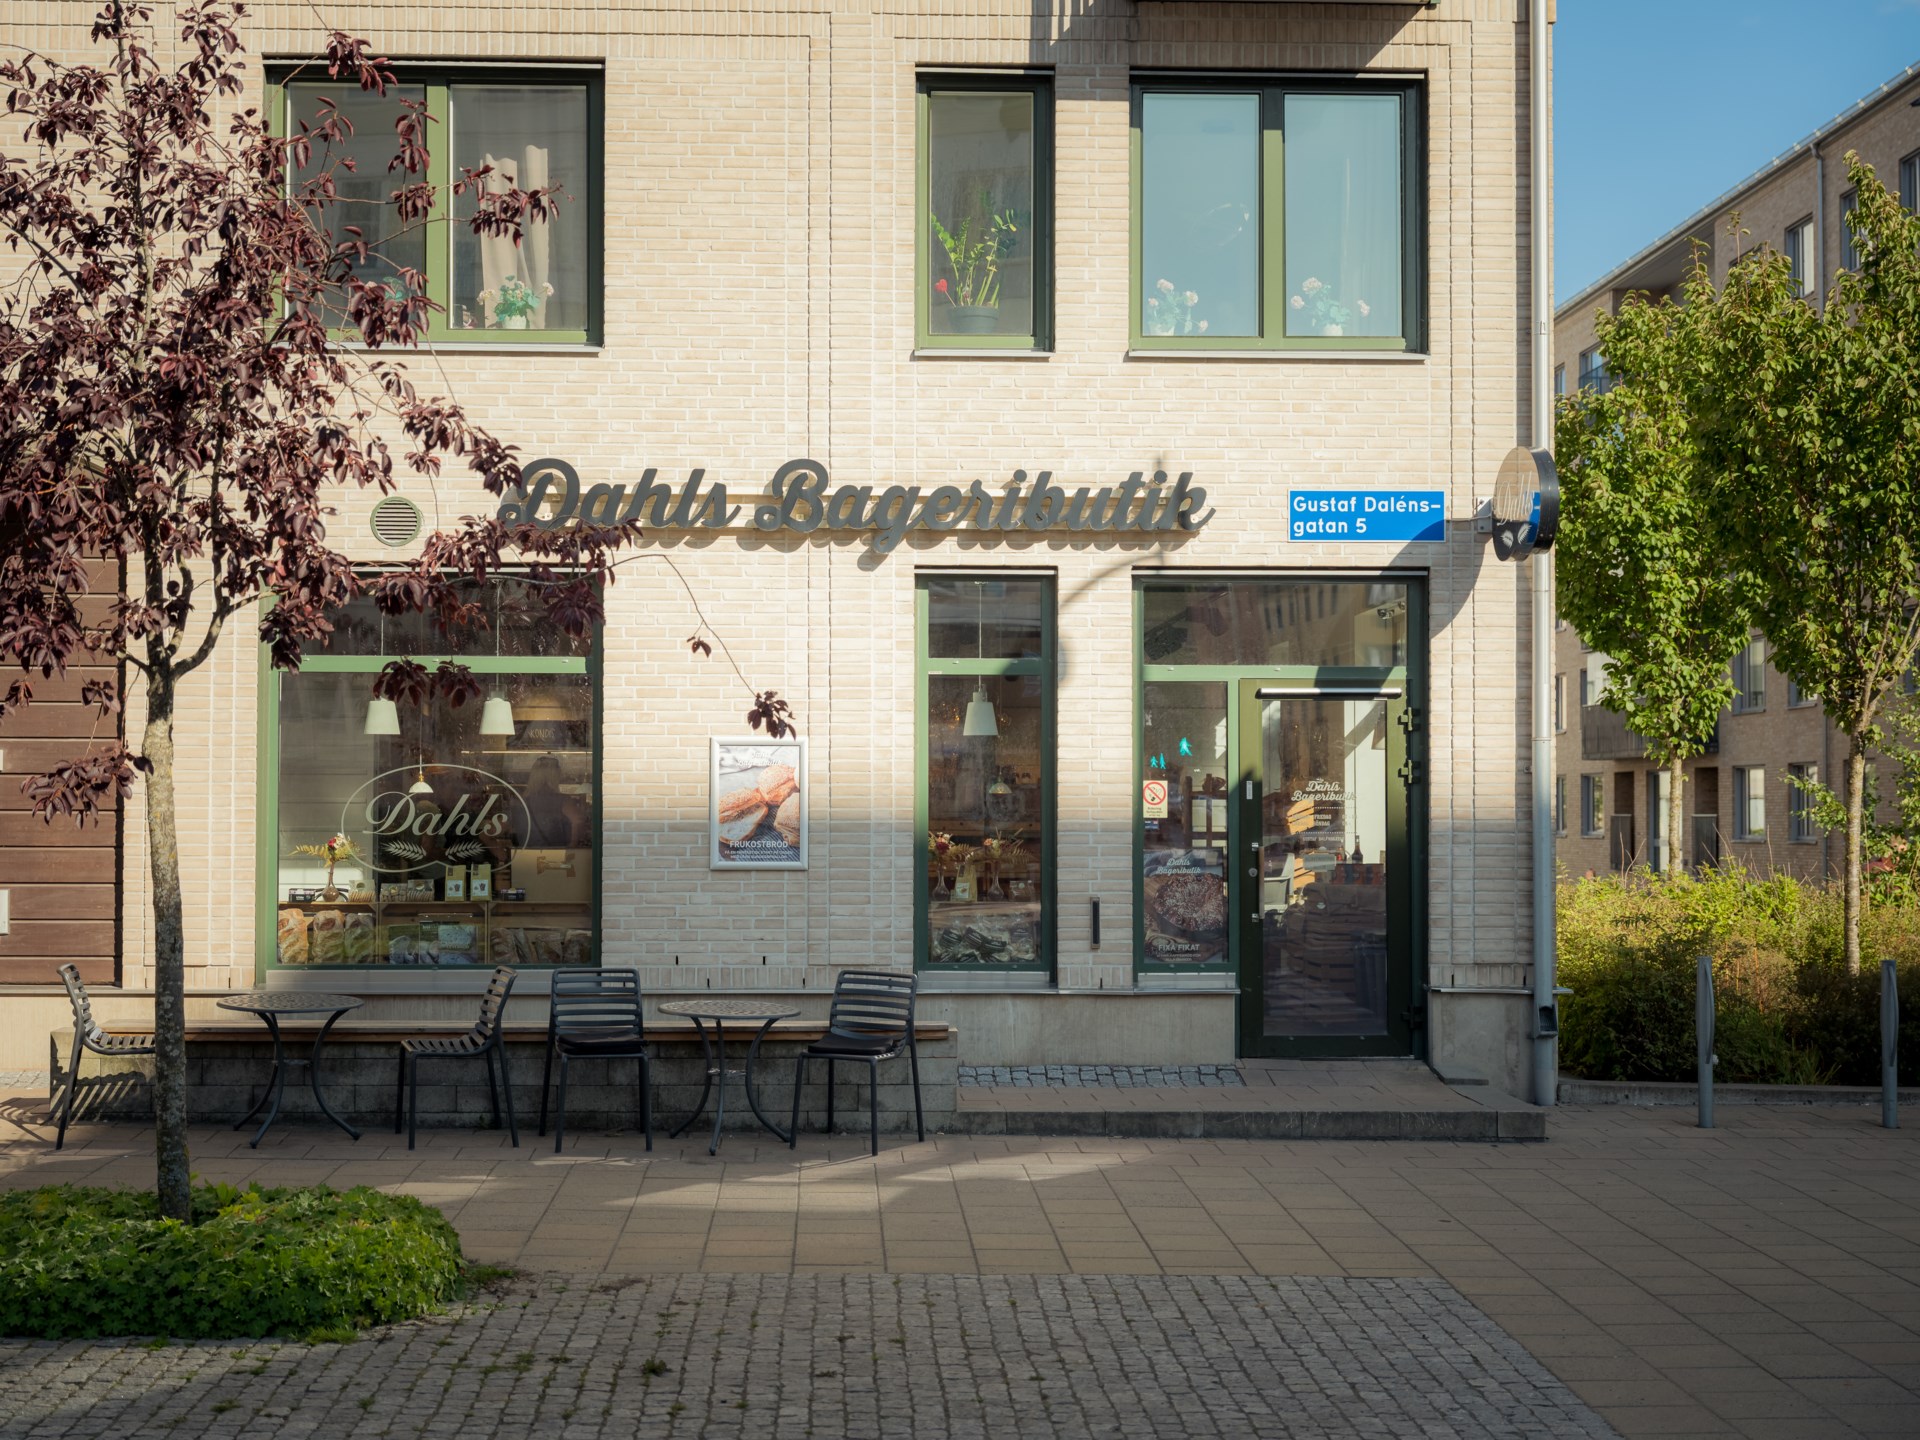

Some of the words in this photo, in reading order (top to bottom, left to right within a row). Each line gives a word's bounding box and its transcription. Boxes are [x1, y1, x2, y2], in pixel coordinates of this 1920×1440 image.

[497, 458, 741, 529] Dahls
[754, 459, 1216, 553] Bageributik
[1293, 495, 1356, 513] Gustaf
[1364, 495, 1441, 513] Daléns-
[1293, 517, 1348, 536] gatan
[1356, 517, 1367, 534] 5
[1305, 780, 1341, 792] Dahls
[362, 790, 508, 837] Dahls
[1158, 943, 1175, 951] FIXA
[1177, 943, 1200, 951] FIKAT
